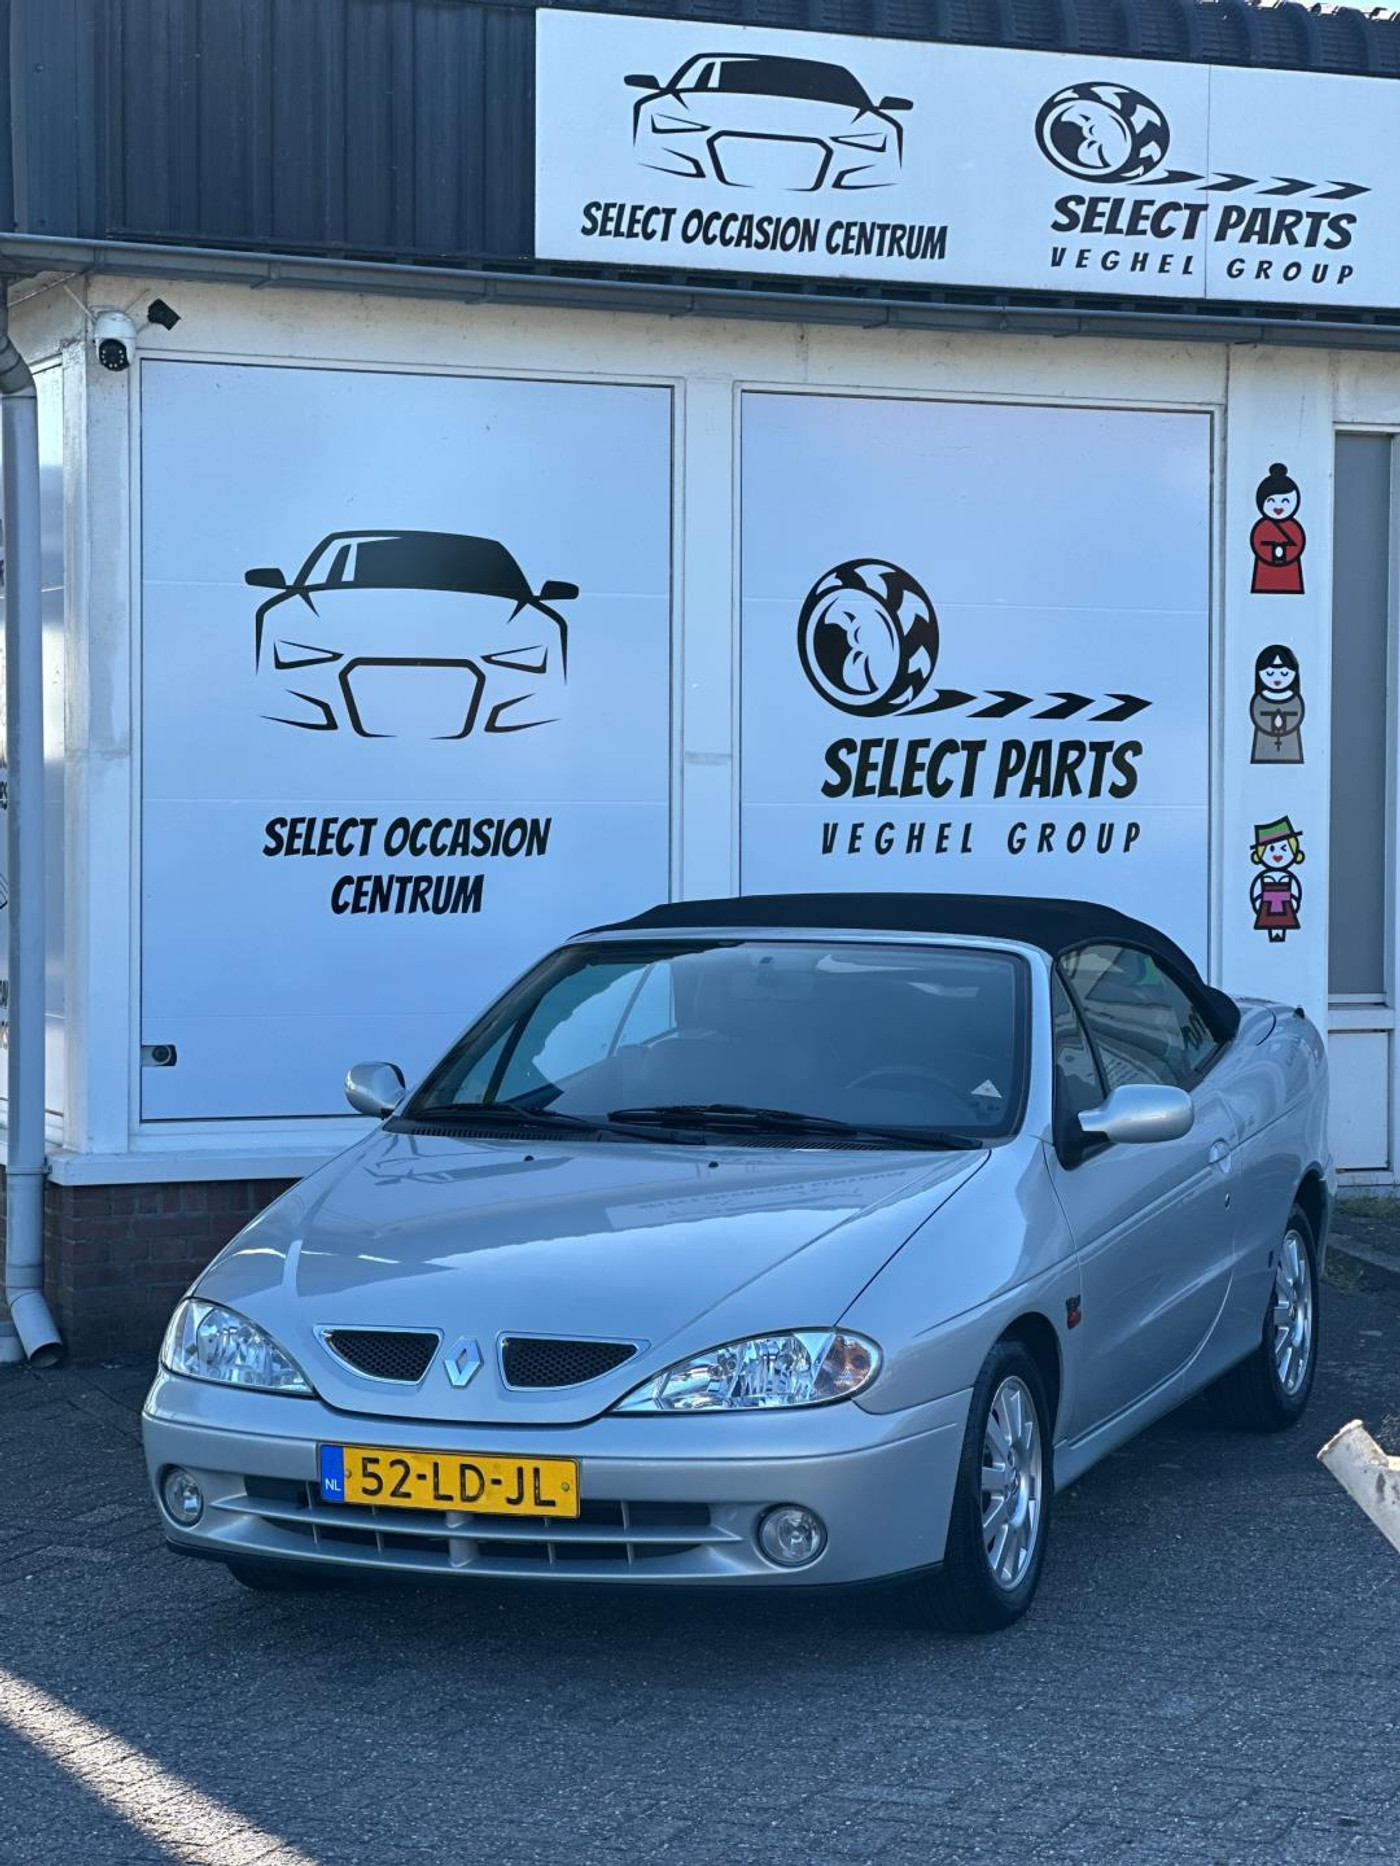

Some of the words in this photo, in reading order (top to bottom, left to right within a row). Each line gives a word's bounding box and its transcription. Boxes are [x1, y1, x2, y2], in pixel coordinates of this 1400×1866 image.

[580, 200, 677, 242] SELECT
[681, 208, 821, 253] OCCASION
[825, 220, 949, 260] CENTRUM
[1050, 194, 1210, 241] SELECT
[1213, 204, 1358, 250] PARTS
[1050, 246, 1195, 275] VEGHEL
[1226, 258, 1355, 285] GROUP
[820, 737, 988, 799] SELECT
[993, 738, 1143, 800] PARTS
[262, 816, 379, 858] SELECT
[383, 816, 553, 858] OCCASION
[821, 821, 973, 855] VEGHEL
[1006, 821, 1141, 855] GROUP
[330, 873, 485, 915] CENTRUM
[324, 1478, 342, 1493] NL
[360, 1456, 557, 1508] 52-LD-JL
